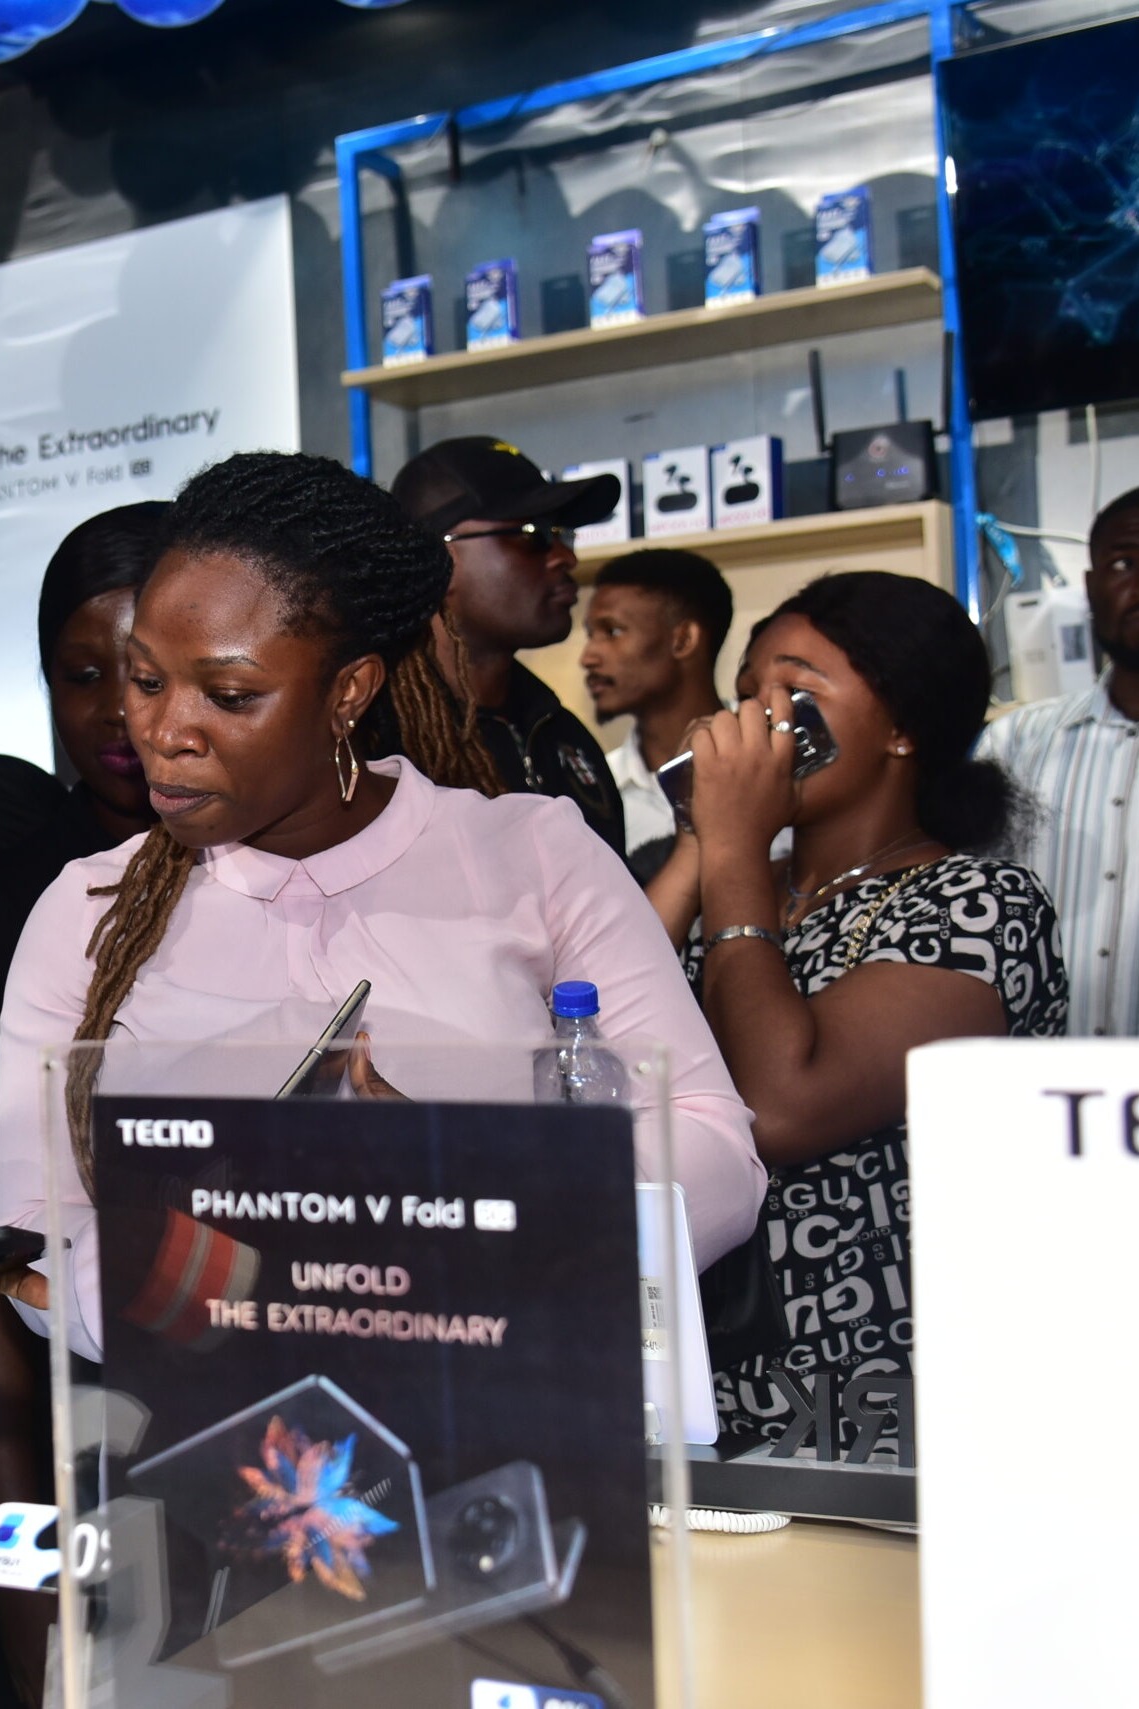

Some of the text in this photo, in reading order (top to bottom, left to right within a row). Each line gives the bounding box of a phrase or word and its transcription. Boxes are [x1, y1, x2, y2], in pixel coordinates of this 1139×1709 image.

[38, 408, 221, 461] Extraordinary
[64, 471, 79, 488] V
[86, 464, 124, 486] Fold
[116, 1118, 214, 1148] TECNO
[191, 1188, 356, 1223] PHANTOM
[365, 1195, 390, 1224] V
[402, 1195, 465, 1230] Fold
[291, 1260, 411, 1296] UNFOLD
[206, 1298, 508, 1347] THE EXTRAORDINARY
